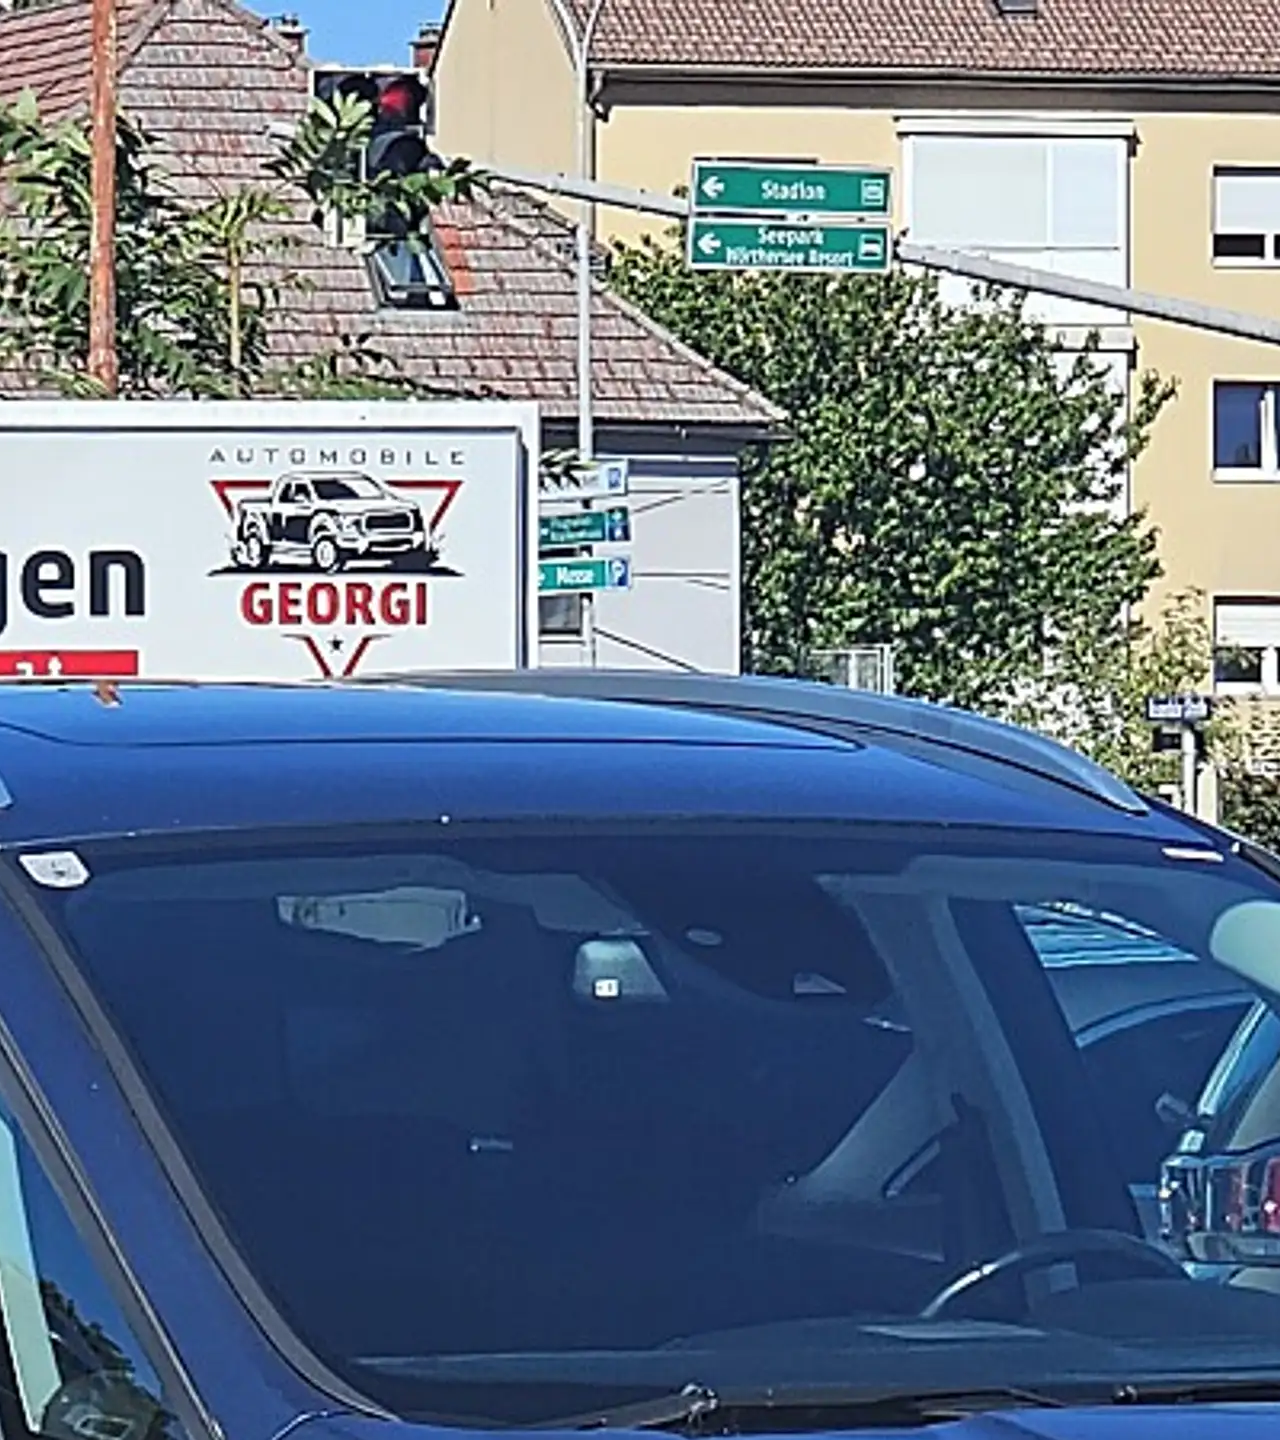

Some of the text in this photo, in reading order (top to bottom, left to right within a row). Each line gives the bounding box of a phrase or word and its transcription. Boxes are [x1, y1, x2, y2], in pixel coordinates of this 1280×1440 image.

[761, 180, 826, 201] Stadion
[758, 226, 825, 246] Seepark
[208, 448, 466, 466] AUTOMOBILE
[240, 581, 428, 626] GEORGI
